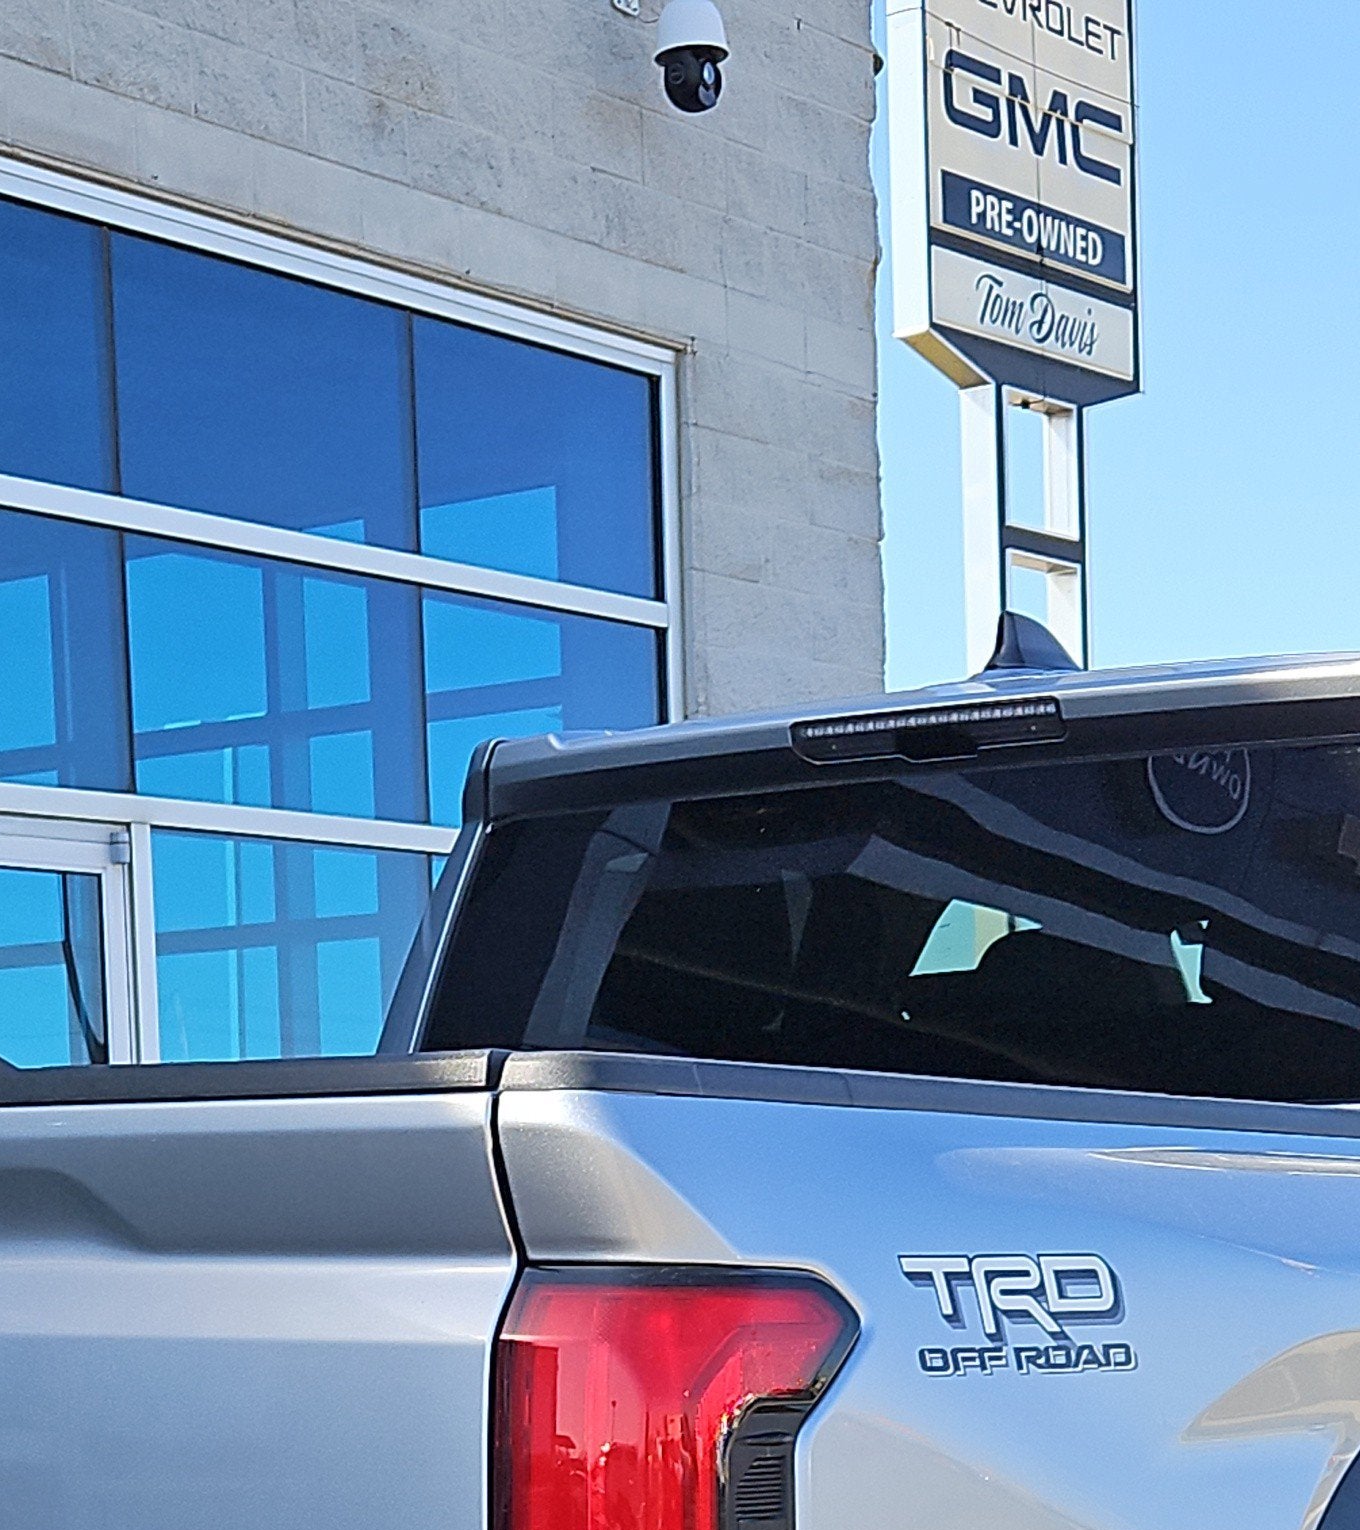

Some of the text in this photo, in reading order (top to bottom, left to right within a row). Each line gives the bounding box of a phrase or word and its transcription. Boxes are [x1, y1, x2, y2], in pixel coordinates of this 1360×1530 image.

[943, 49, 1124, 186] GMC
[970, 188, 1103, 267] PRE-OWNED
[975, 273, 1098, 356] Tom Davis
[897, 1252, 1126, 1348] TRD
[919, 1343, 1138, 1376] OFF ROAD
